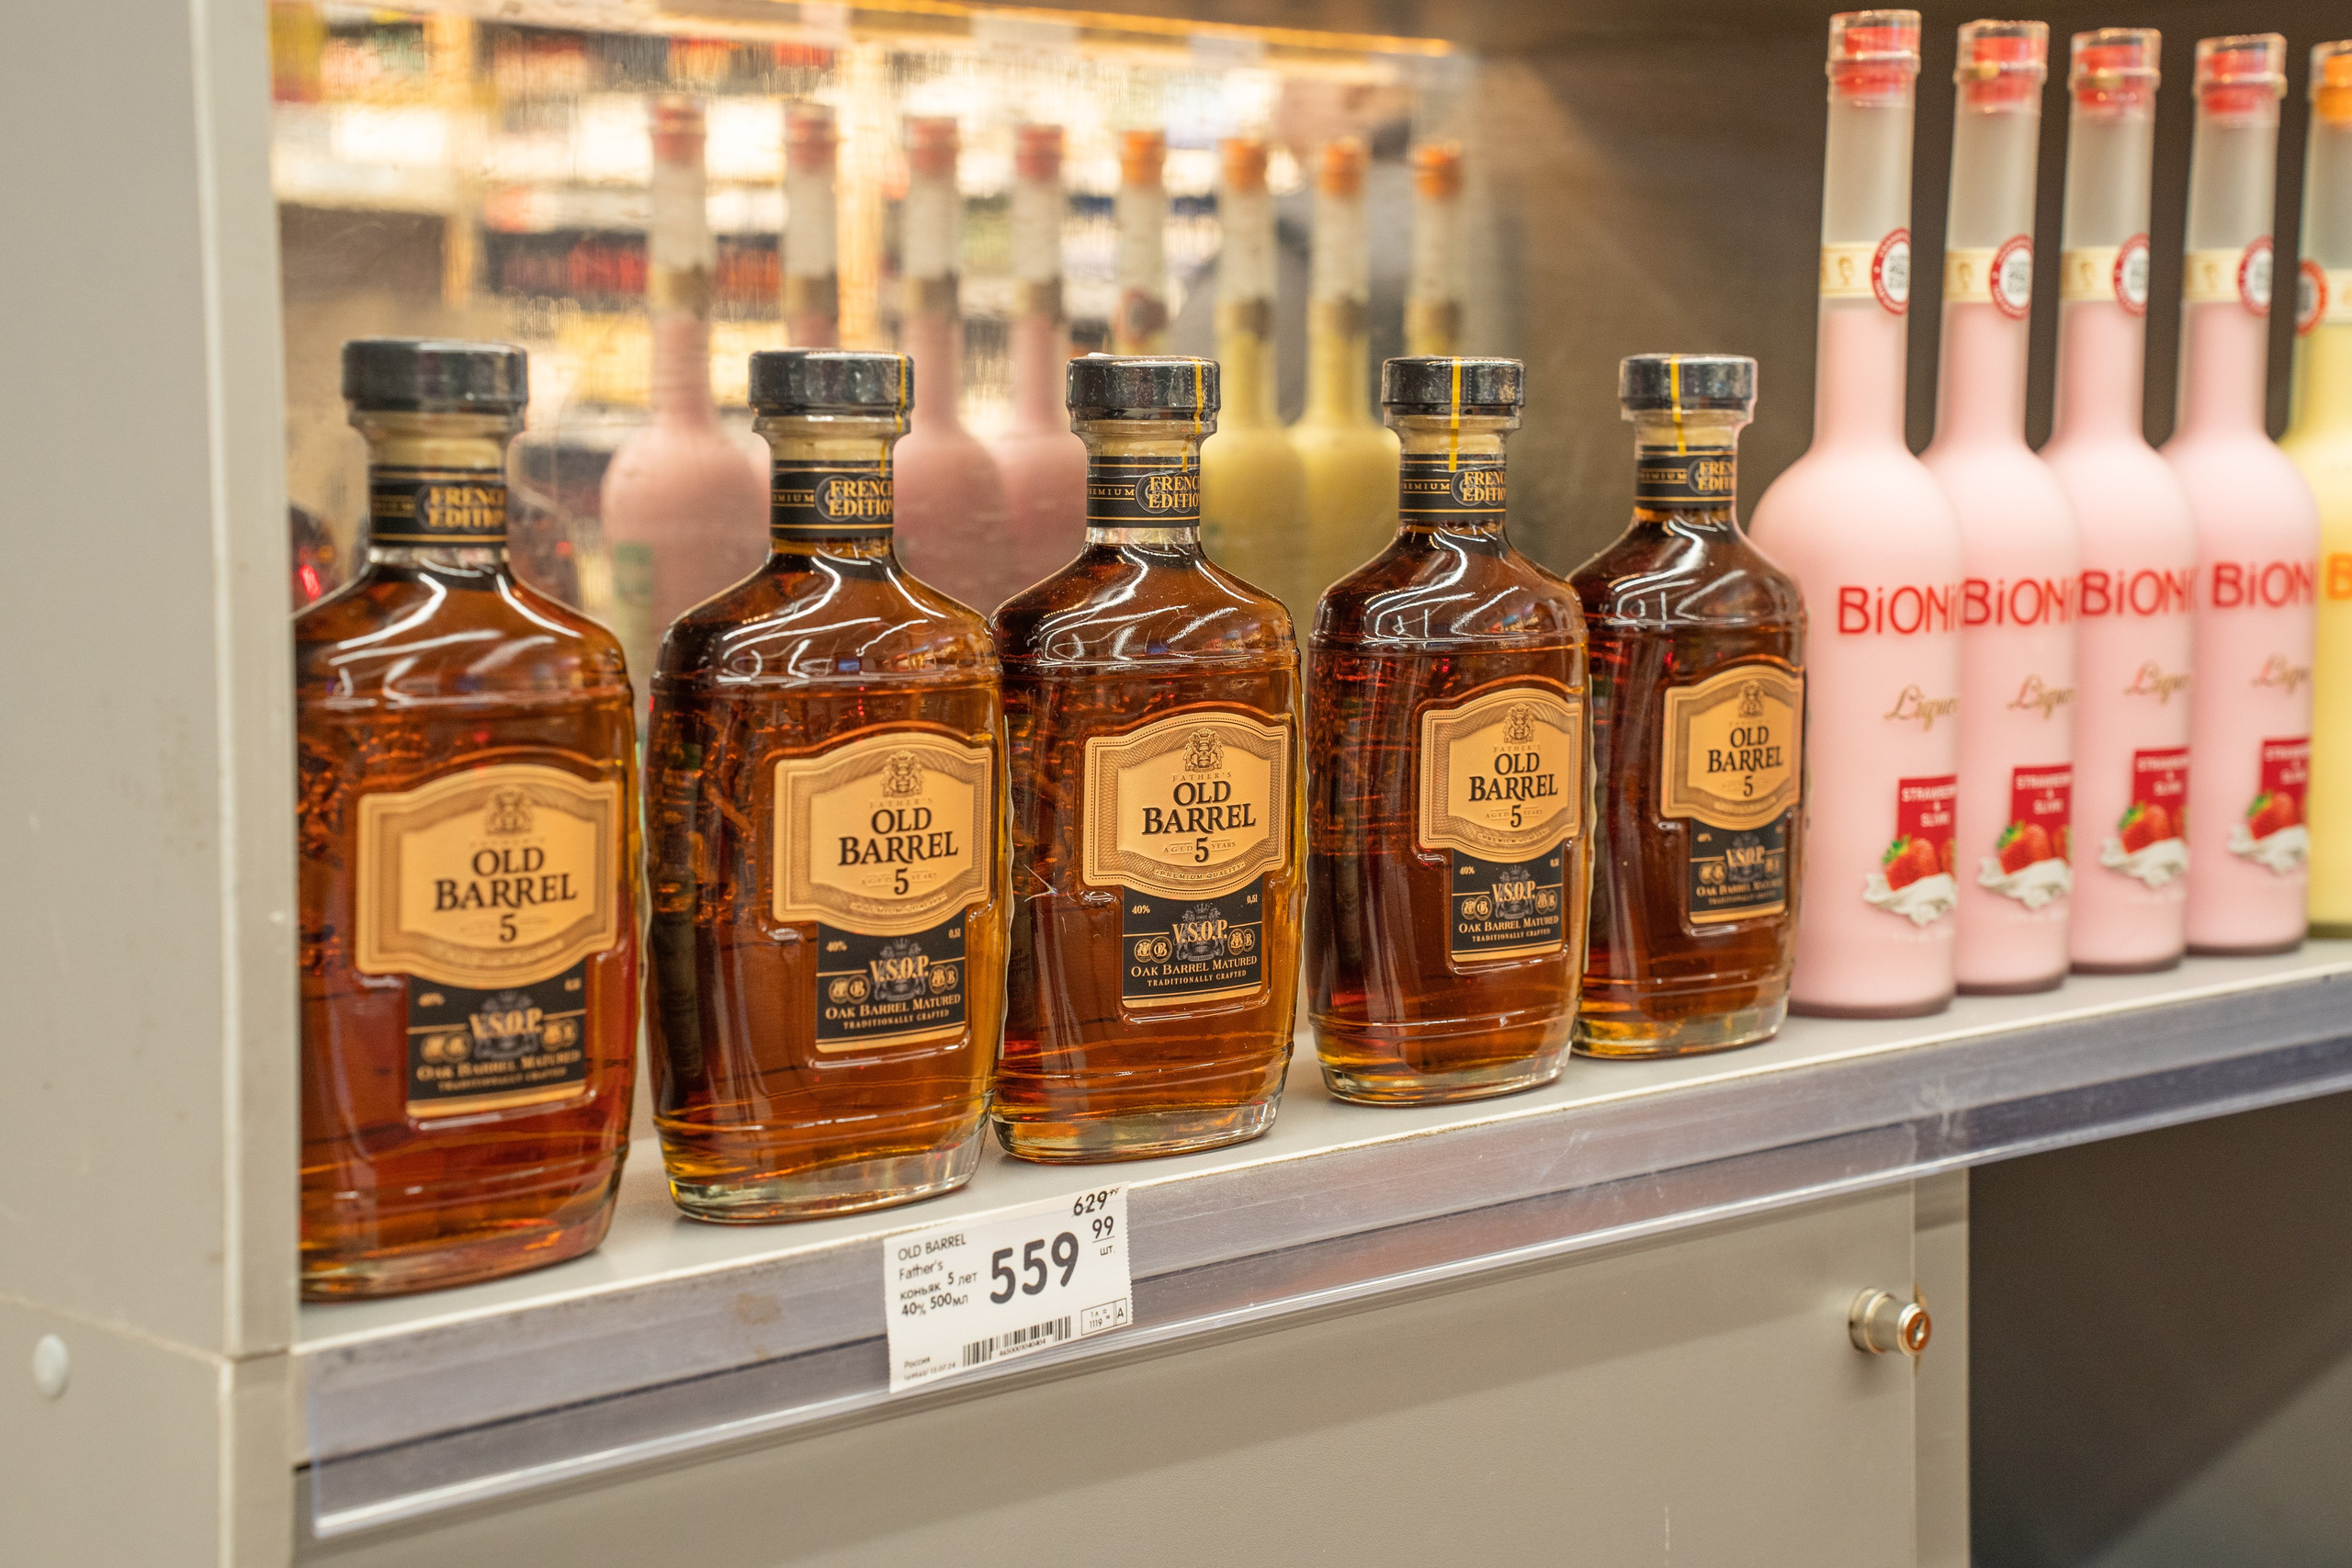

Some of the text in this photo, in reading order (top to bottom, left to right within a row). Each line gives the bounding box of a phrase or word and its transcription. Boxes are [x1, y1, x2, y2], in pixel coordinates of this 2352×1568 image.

[1494, 745, 1541, 753] FATHER'S
[1730, 726, 1770, 748] OLD
[1494, 752, 1540, 775] OLD
[1708, 746, 1783, 773] BARREL
[1172, 771, 1231, 782] FATHER'S
[1468, 773, 1558, 802] BARREL
[1743, 775, 1754, 797] 5
[1173, 780, 1231, 807] OLD
[871, 807, 932, 834] OLD
[1142, 802, 1256, 835] BARREL
[1510, 804, 1522, 828] 5
[838, 830, 958, 866] BARREL
[1194, 836, 1209, 863] 5
[1211, 841, 1235, 850] YEARS
[472, 846, 544, 877] OLD
[1159, 863, 1241, 880] PREMIUM QUALITY
[1459, 865, 1475, 875] 40%
[434, 873, 578, 912] BARREL
[894, 867, 909, 895] 5
[1492, 880, 1536, 902] V.S.O.P.
[1131, 905, 1150, 915] 40%
[498, 913, 517, 942] 5
[1172, 919, 1228, 943] V.S.O.P.
[1459, 915, 1560, 934] OAK BARREL MATURED
[1472, 931, 1524, 942] TRADITIONALLY
[869, 954, 929, 982] V.S.O.P.
[1131, 955, 1257, 977] OAK BARREL MATURED
[1148, 970, 1247, 987] TRADITIONALLY CRAFTED
[825, 994, 961, 1020] OAK BARREL MATURED
[843, 1010, 950, 1030] TRADITIONALLY CRAFTED
[1092, 1215, 1114, 1239] 99
[899, 1234, 967, 1261] OLD BARREL
[1100, 1245, 1115, 1256] шт.
[899, 1259, 944, 1280] Father's
[990, 1232, 1079, 1303] 559
[899, 1271, 978, 1301] коньяк 5 лет
[901, 1292, 968, 1316] 40% 500мл
[1089, 1318, 1102, 1329] 1119
